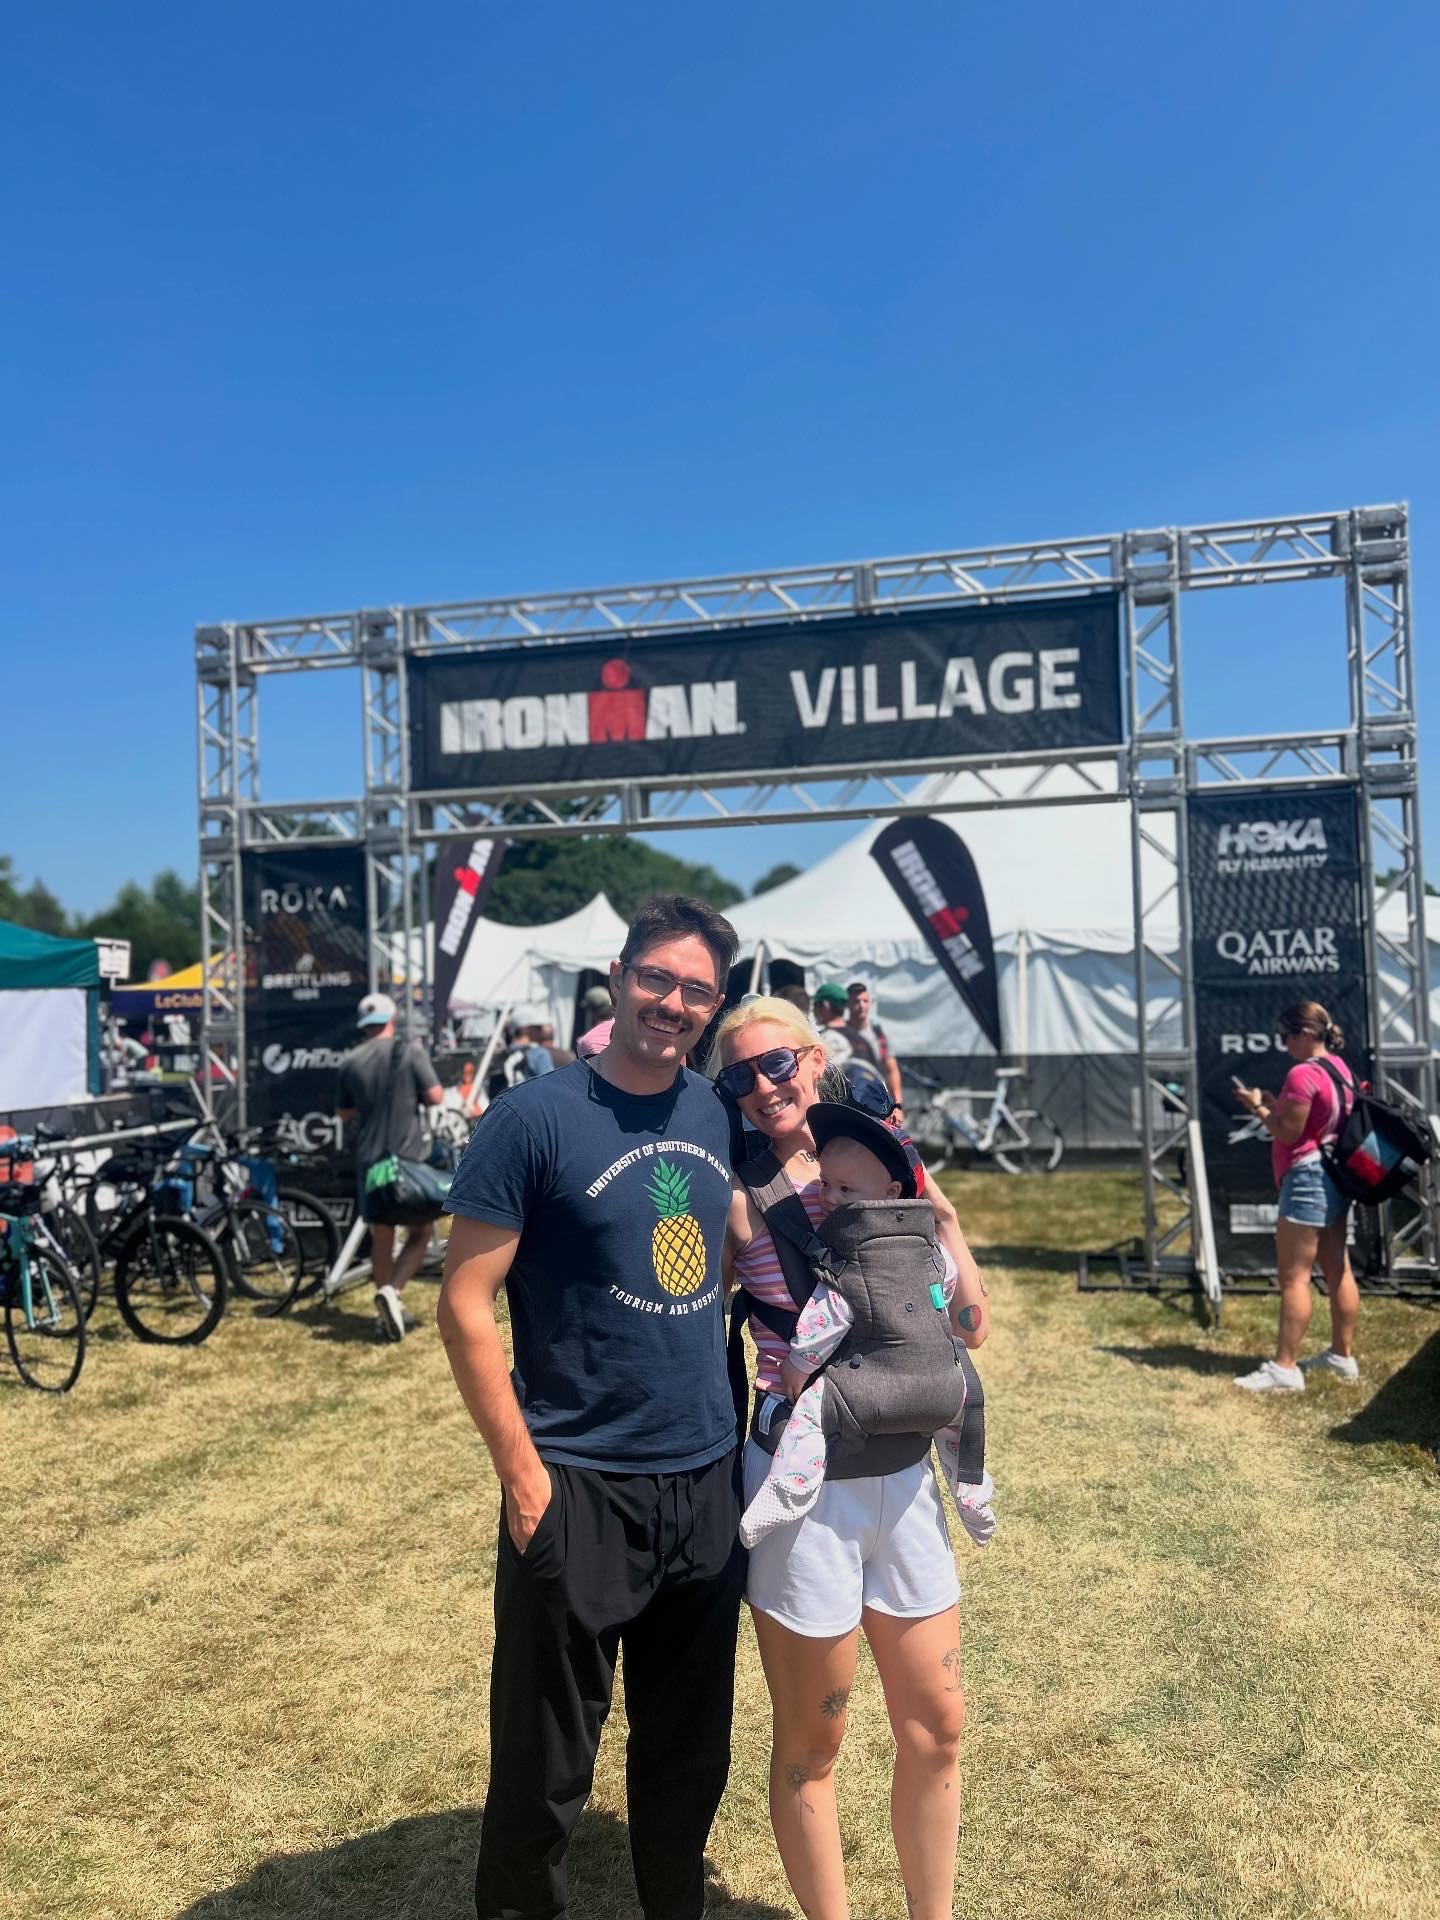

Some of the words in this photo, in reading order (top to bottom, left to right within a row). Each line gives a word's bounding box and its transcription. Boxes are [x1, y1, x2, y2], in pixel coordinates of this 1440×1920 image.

[789, 647, 1082, 729] VILLAGE
[1217, 817, 1328, 855] HOKA
[1216, 926, 1338, 965] QATAR
[262, 971, 352, 990] BREITLING
[1247, 954, 1340, 976] AIRWAYS
[585, 1147, 642, 1198] UNIVERSITY
[641, 1143, 655, 1157] OF
[656, 1140, 706, 1159] SOUTHERN
[609, 1284, 664, 1314] TOURISM
[669, 1303, 689, 1316] AND
